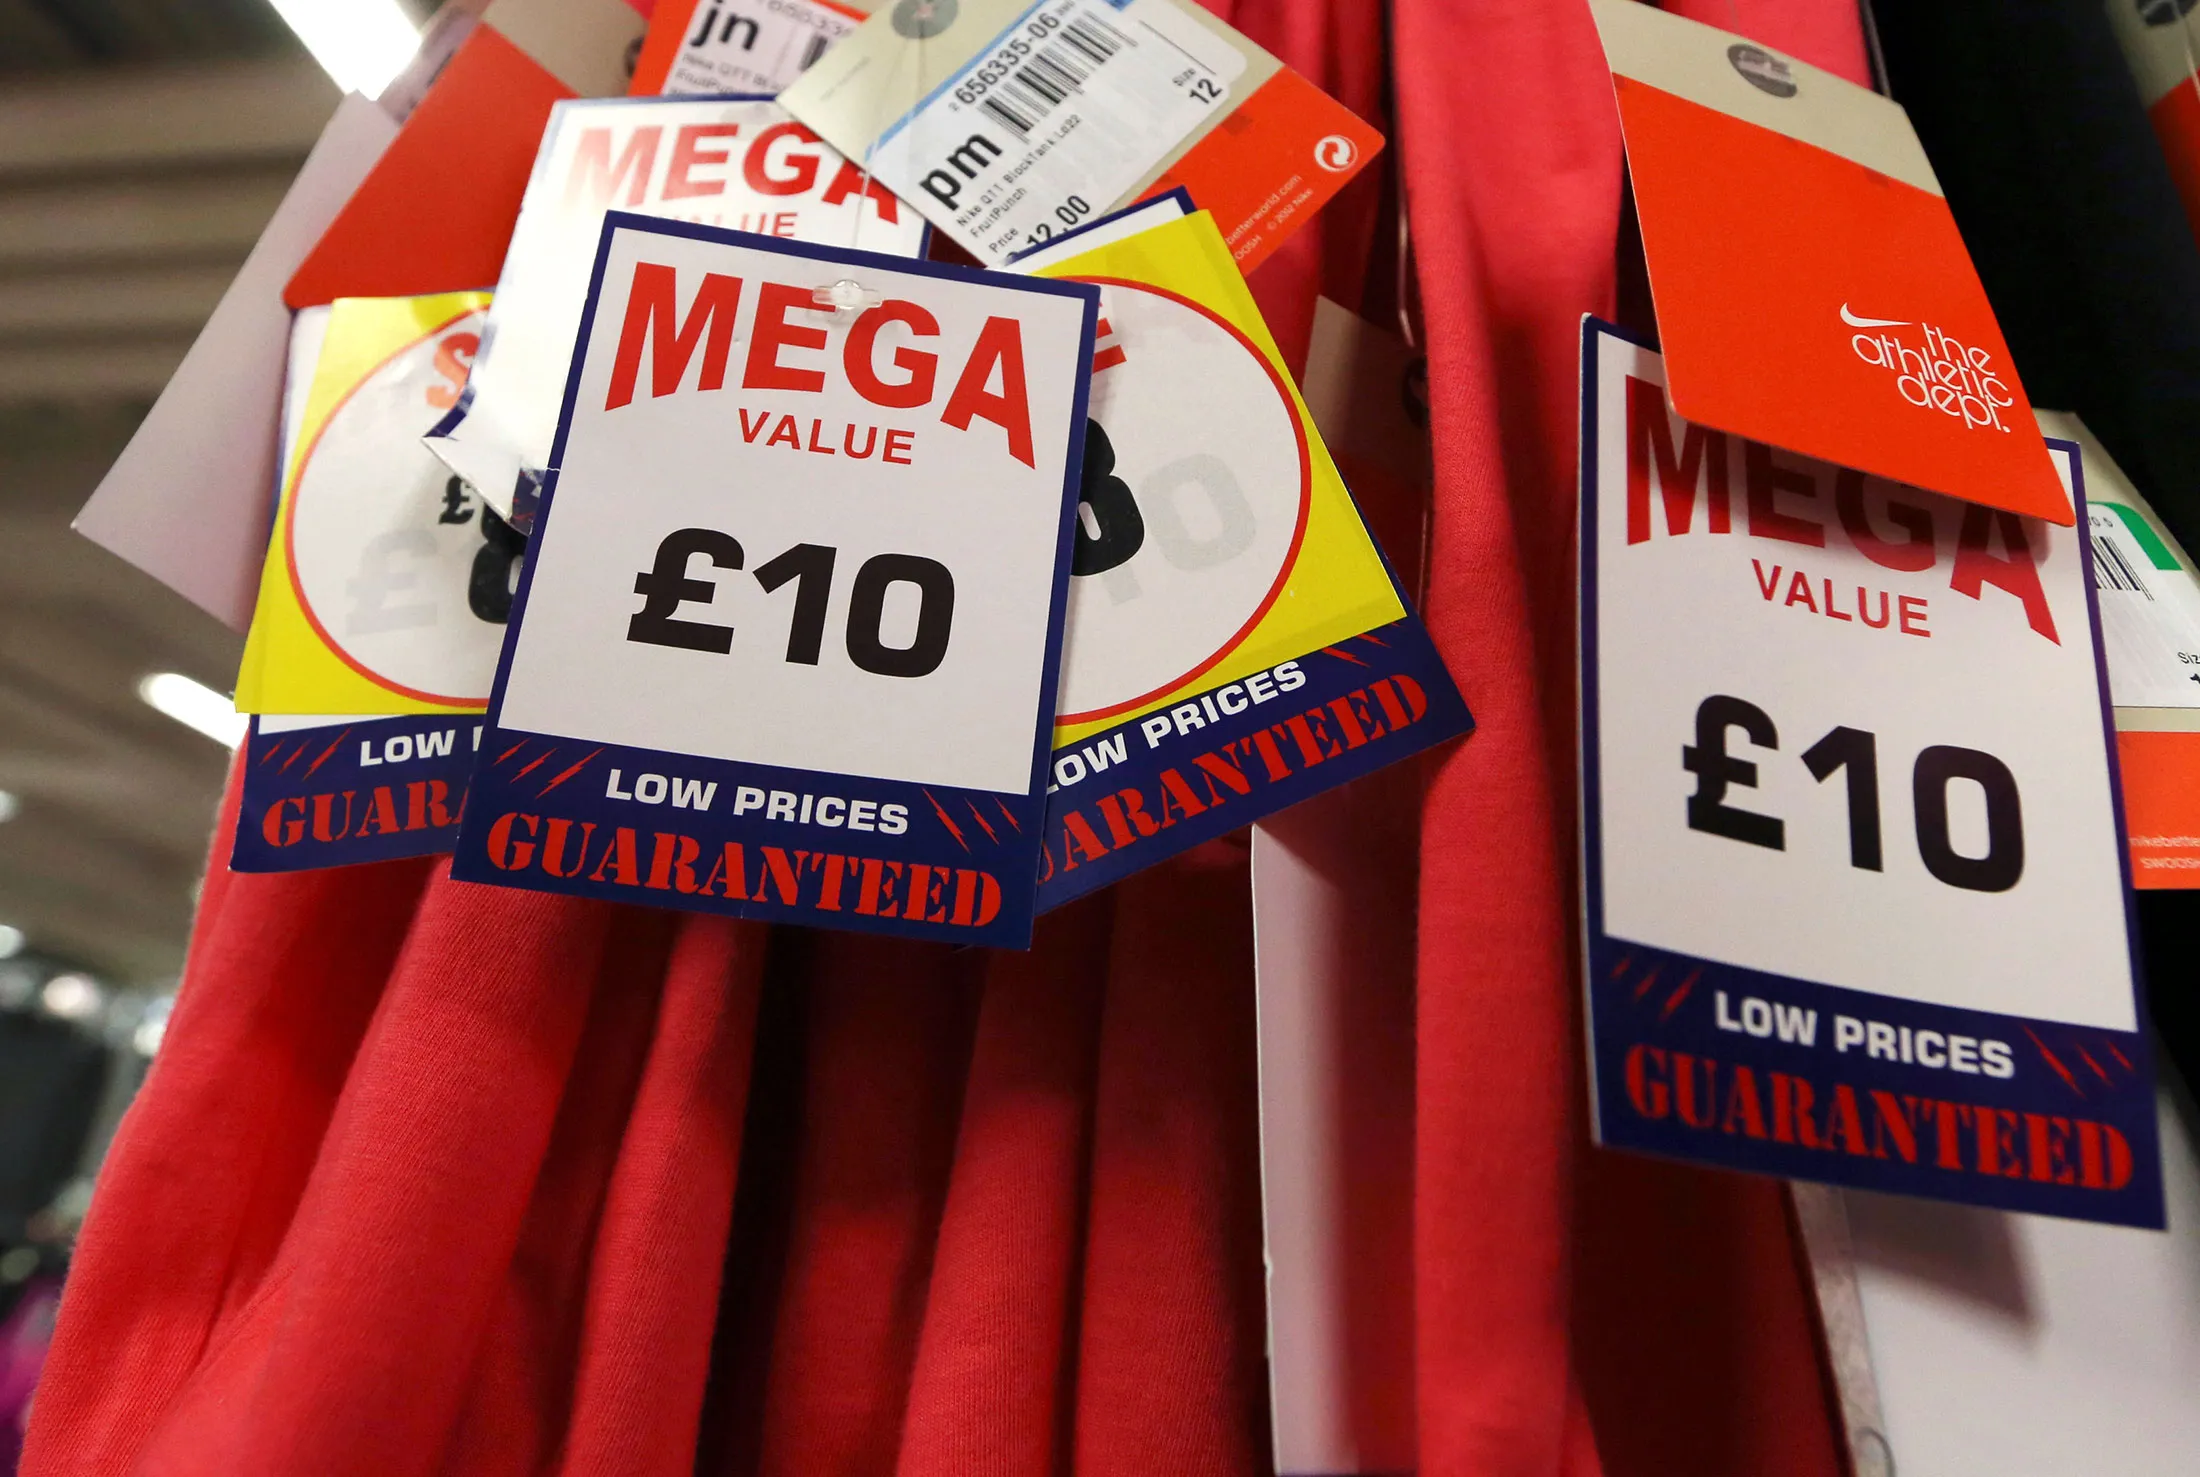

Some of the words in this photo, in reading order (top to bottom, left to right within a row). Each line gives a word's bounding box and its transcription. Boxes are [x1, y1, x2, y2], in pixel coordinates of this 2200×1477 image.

[689, 0, 760, 51] jn
[955, 12, 1060, 104] 656335-06
[1189, 78, 1223, 104] 12
[564, 121, 899, 226] MEGA
[918, 133, 1002, 211] pm
[957, 205, 982, 226] Nike
[988, 228, 1019, 253] Price
[604, 261, 1036, 470] MEGA
[1852, 334, 2013, 407] athletic
[1922, 322, 1996, 377] the
[738, 407, 916, 465] VALUE
[1897, 371, 2011, 433] dept.
[1625, 374, 2062, 647] MEGA
[626, 527, 955, 679] £10
[1751, 559, 1931, 638] VALUE
[2177, 651, 2200, 665] Siz
[1140, 661, 1307, 749] PRICES
[359, 729, 456, 767] LOW
[262, 779, 469, 848] GUAR
[605, 768, 717, 811] LOW
[733, 786, 910, 835] PRICES
[1682, 694, 2024, 893] £10
[486, 812, 1001, 928] GUARANTEED
[1714, 990, 1817, 1047] LOW
[1833, 1014, 2016, 1079] PRICES
[1624, 1043, 2133, 1192] GUARANTEED
